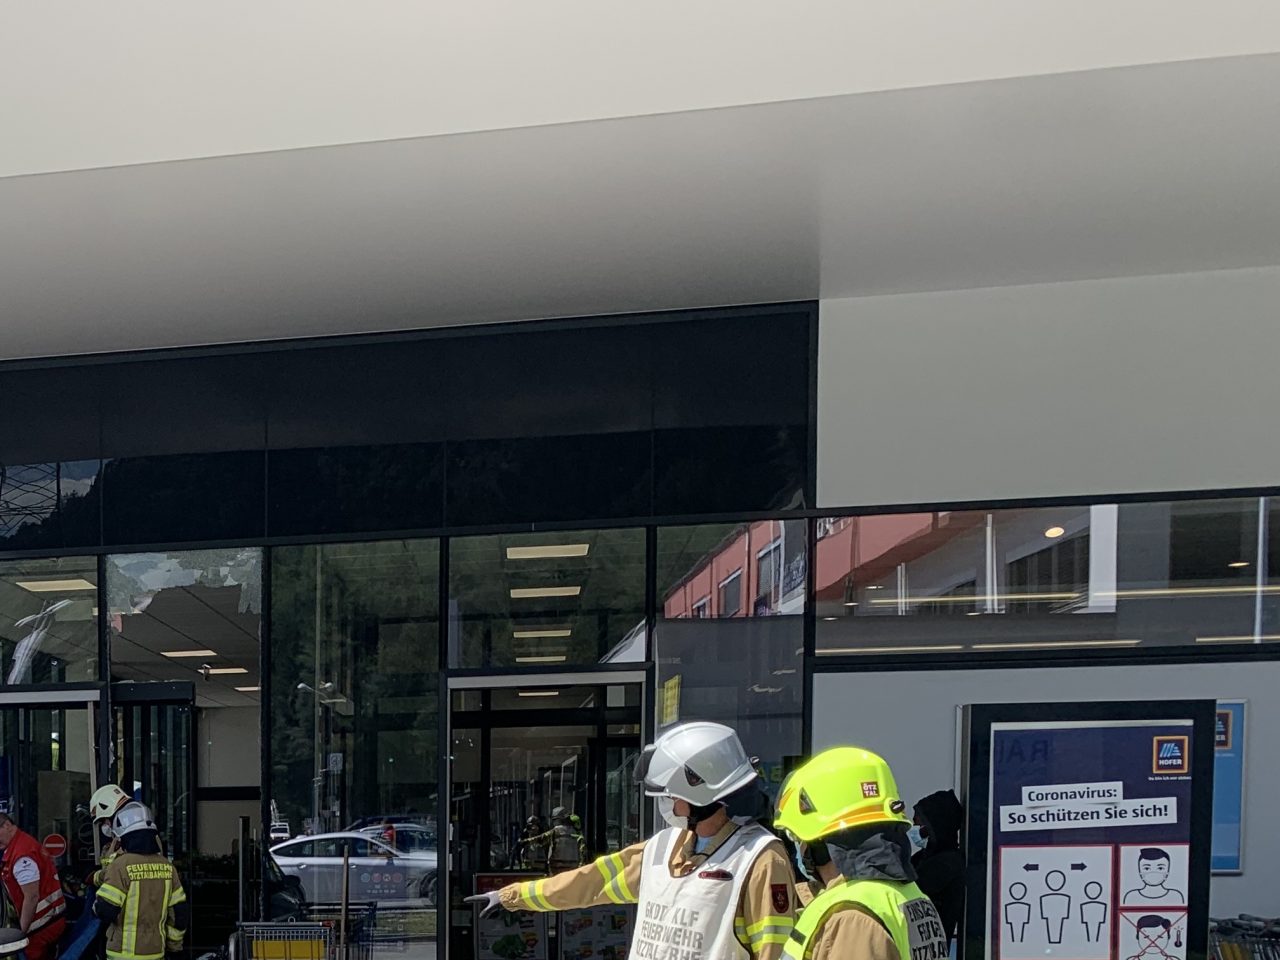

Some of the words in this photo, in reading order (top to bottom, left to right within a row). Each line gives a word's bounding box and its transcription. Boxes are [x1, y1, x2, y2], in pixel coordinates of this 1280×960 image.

[1158, 758, 1183, 767] HOFER
[1027, 786, 1118, 802] Coronavirus:
[1008, 811, 1027, 825] So
[1030, 808, 1101, 823] schützen
[1104, 806, 1128, 820] Sie
[1132, 804, 1169, 818] sich!
[671, 907, 700, 927] KLF
[641, 920, 704, 950] FEUERWEHR
